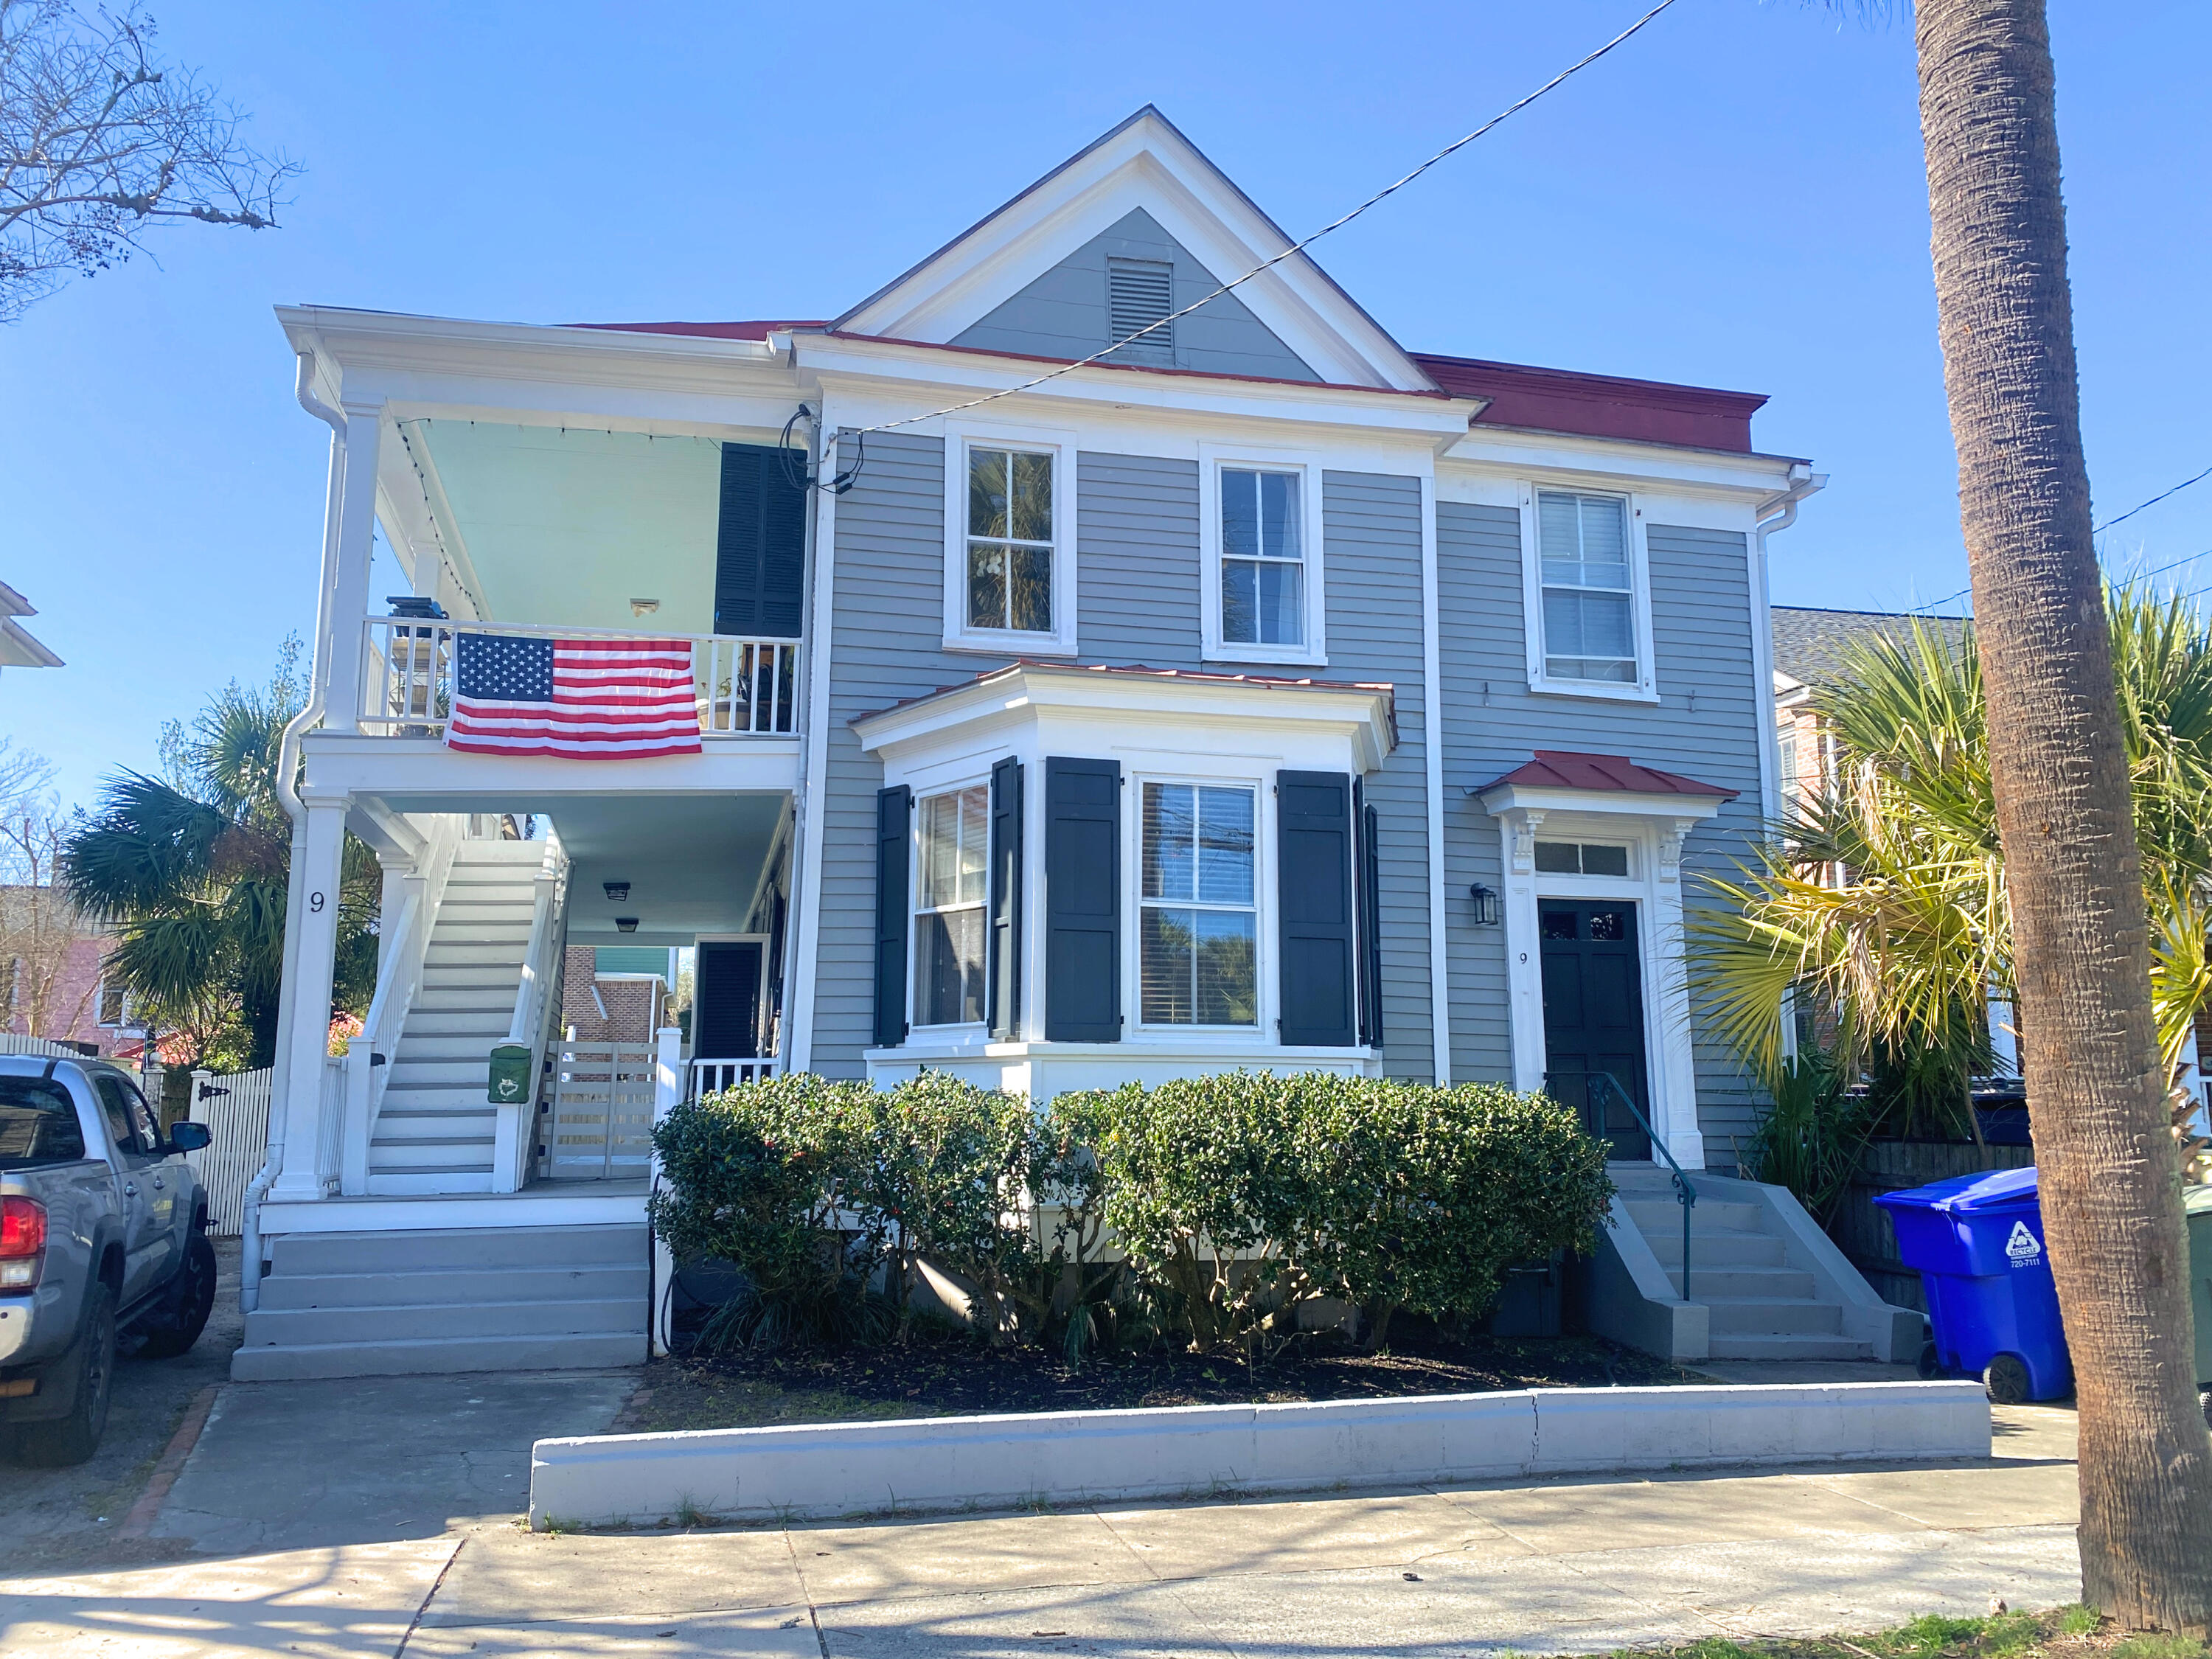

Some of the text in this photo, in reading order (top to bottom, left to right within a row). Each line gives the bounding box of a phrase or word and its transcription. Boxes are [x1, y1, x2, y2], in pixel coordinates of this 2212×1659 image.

[310, 891, 324, 913] 9
[1520, 953, 1527, 964] 9
[2010, 1247, 2037, 1255] RECYCLE
[2011, 1258, 2040, 1268] 720-7111
